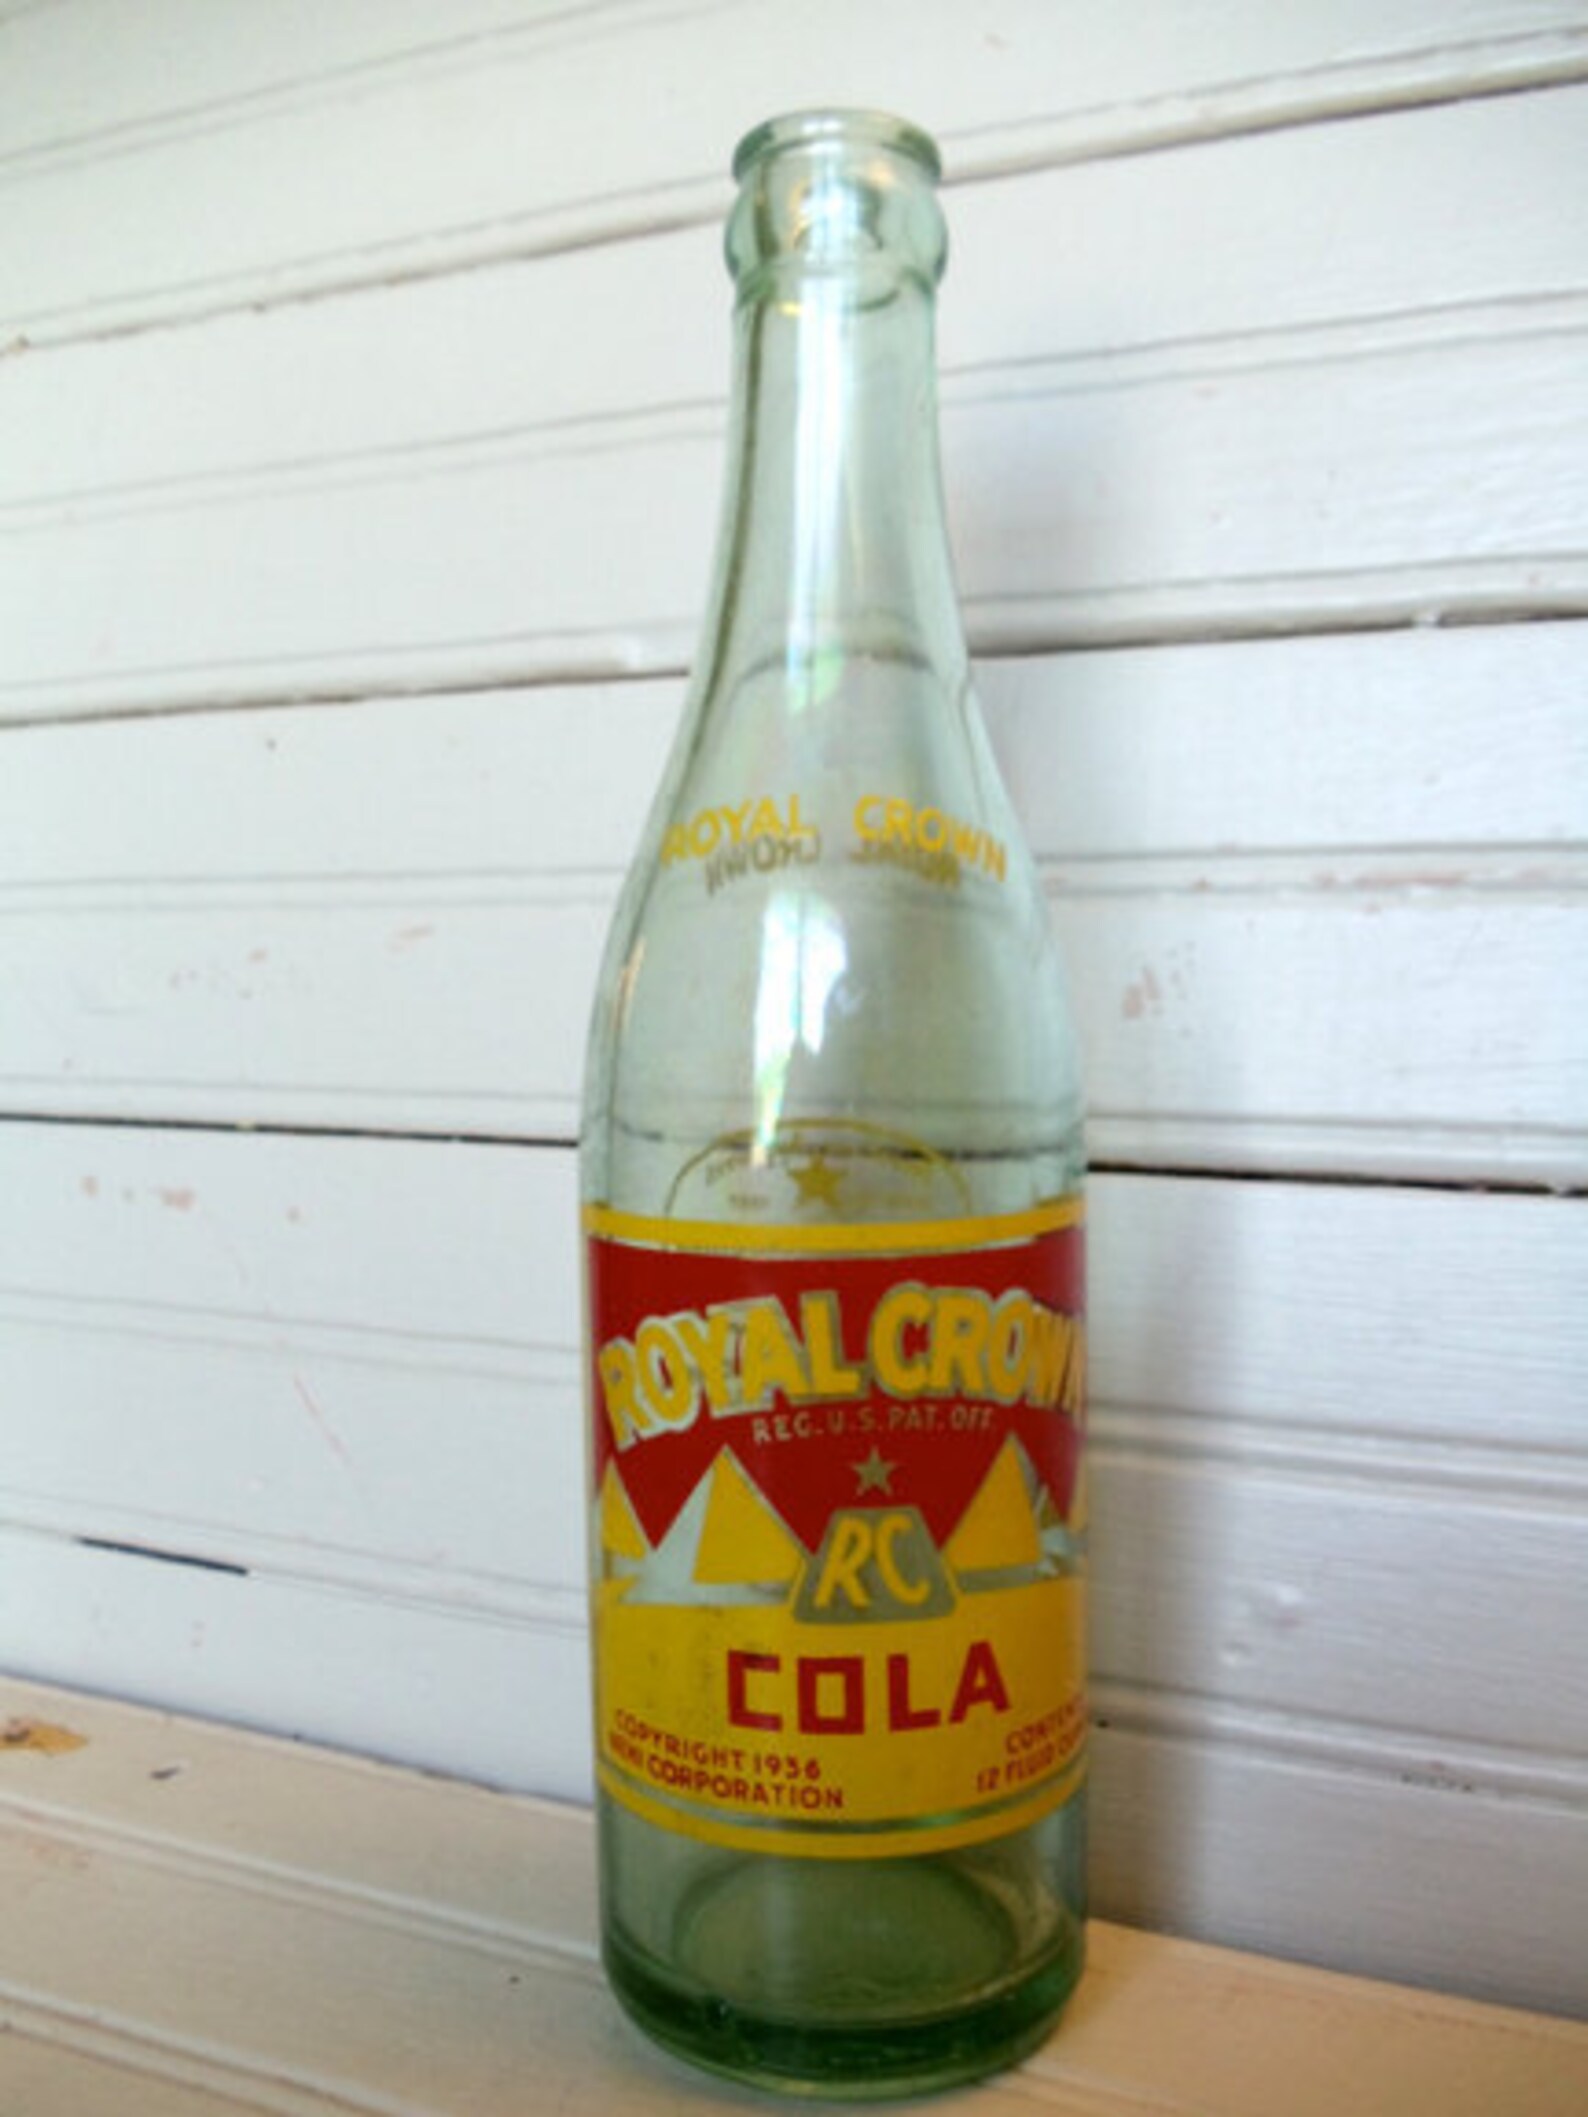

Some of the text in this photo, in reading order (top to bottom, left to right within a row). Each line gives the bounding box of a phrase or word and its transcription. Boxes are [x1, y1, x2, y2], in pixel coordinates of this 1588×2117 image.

[660, 794, 818, 869] ROYAL
[853, 794, 1006, 882] CROWN
[600, 1295, 862, 1450] ROYAL
[815, 1515, 930, 1608] RC
[728, 1640, 1011, 1735] COLA
[615, 1708, 746, 1772] COPYRIGHT
[647, 1754, 843, 1809] CORPORATION
